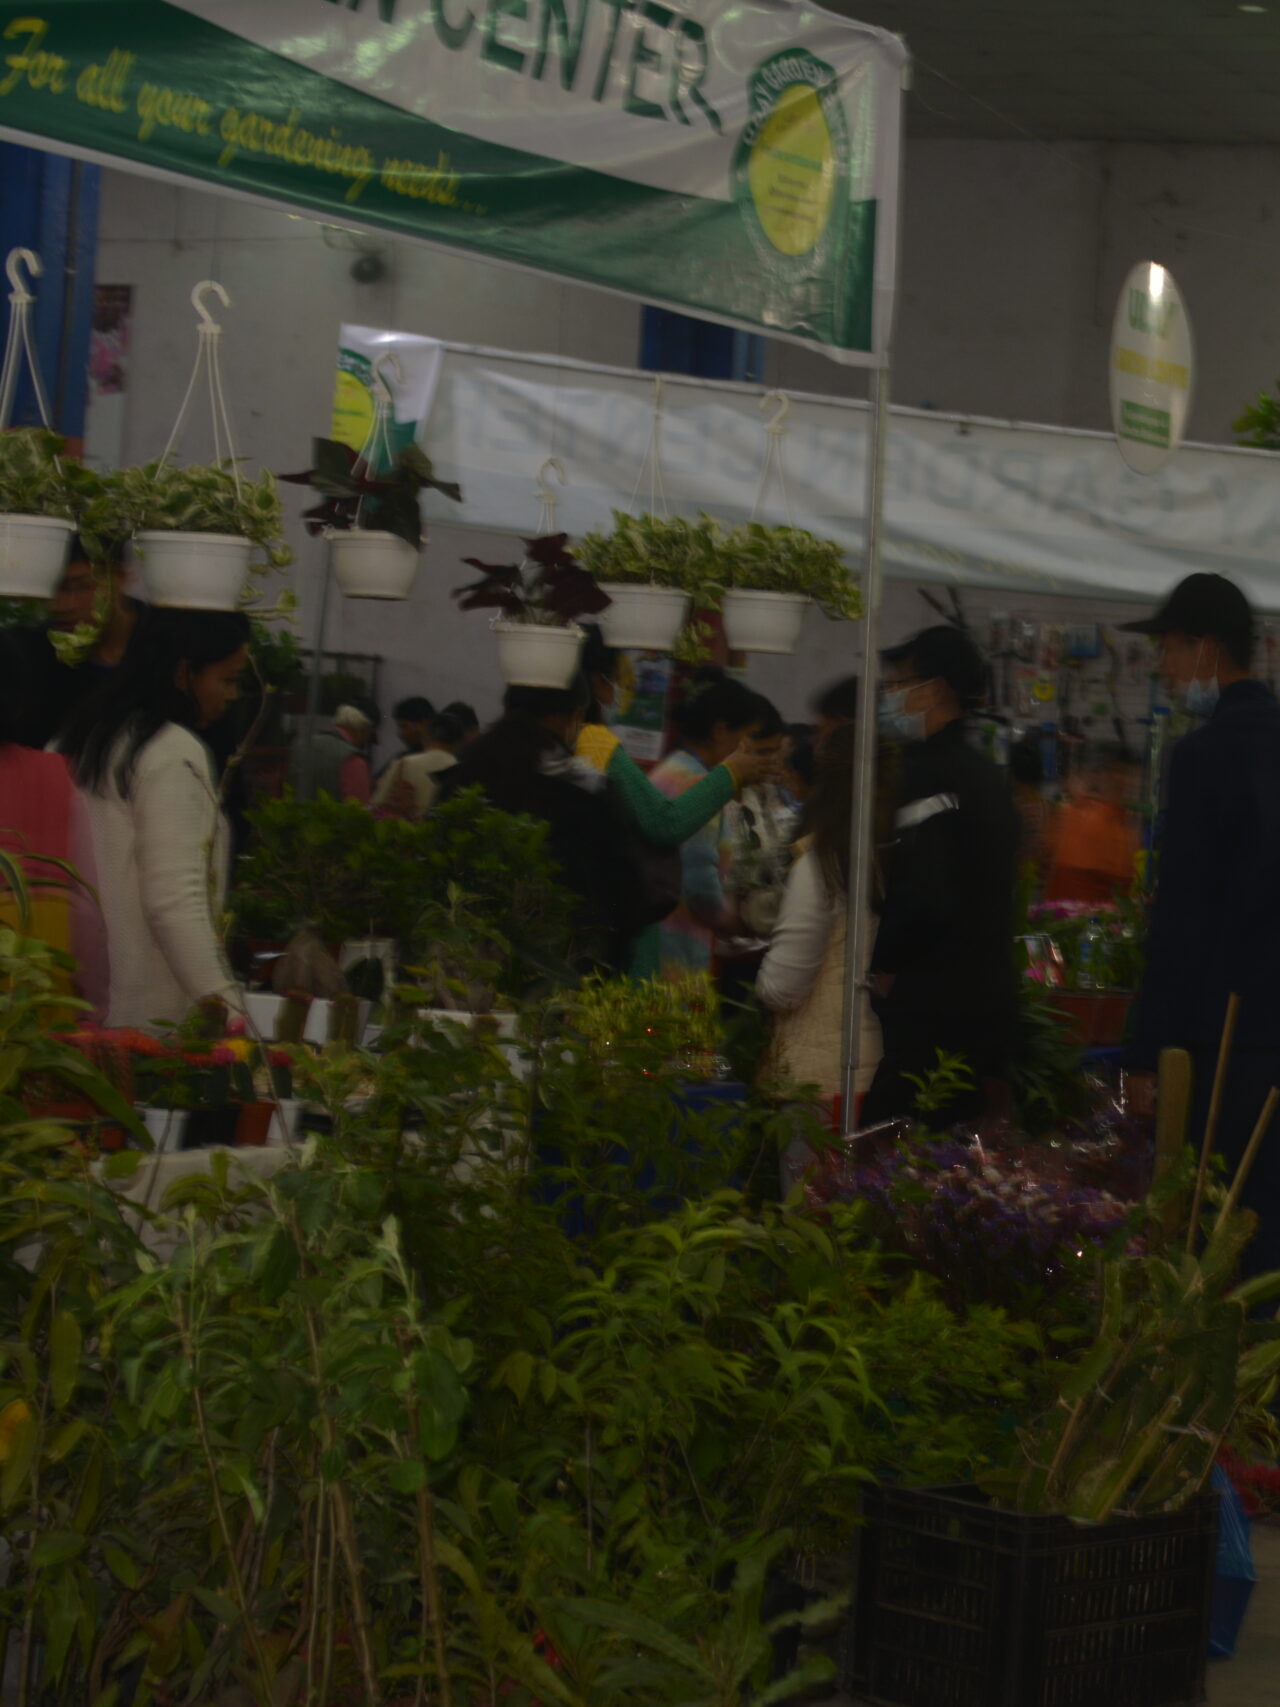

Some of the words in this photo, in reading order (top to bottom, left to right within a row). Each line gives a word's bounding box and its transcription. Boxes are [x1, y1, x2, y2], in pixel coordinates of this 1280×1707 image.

[0, 16, 69, 97] For
[75, 47, 136, 114] all
[137, 81, 213, 142] your
[217, 105, 374, 202] gardening
